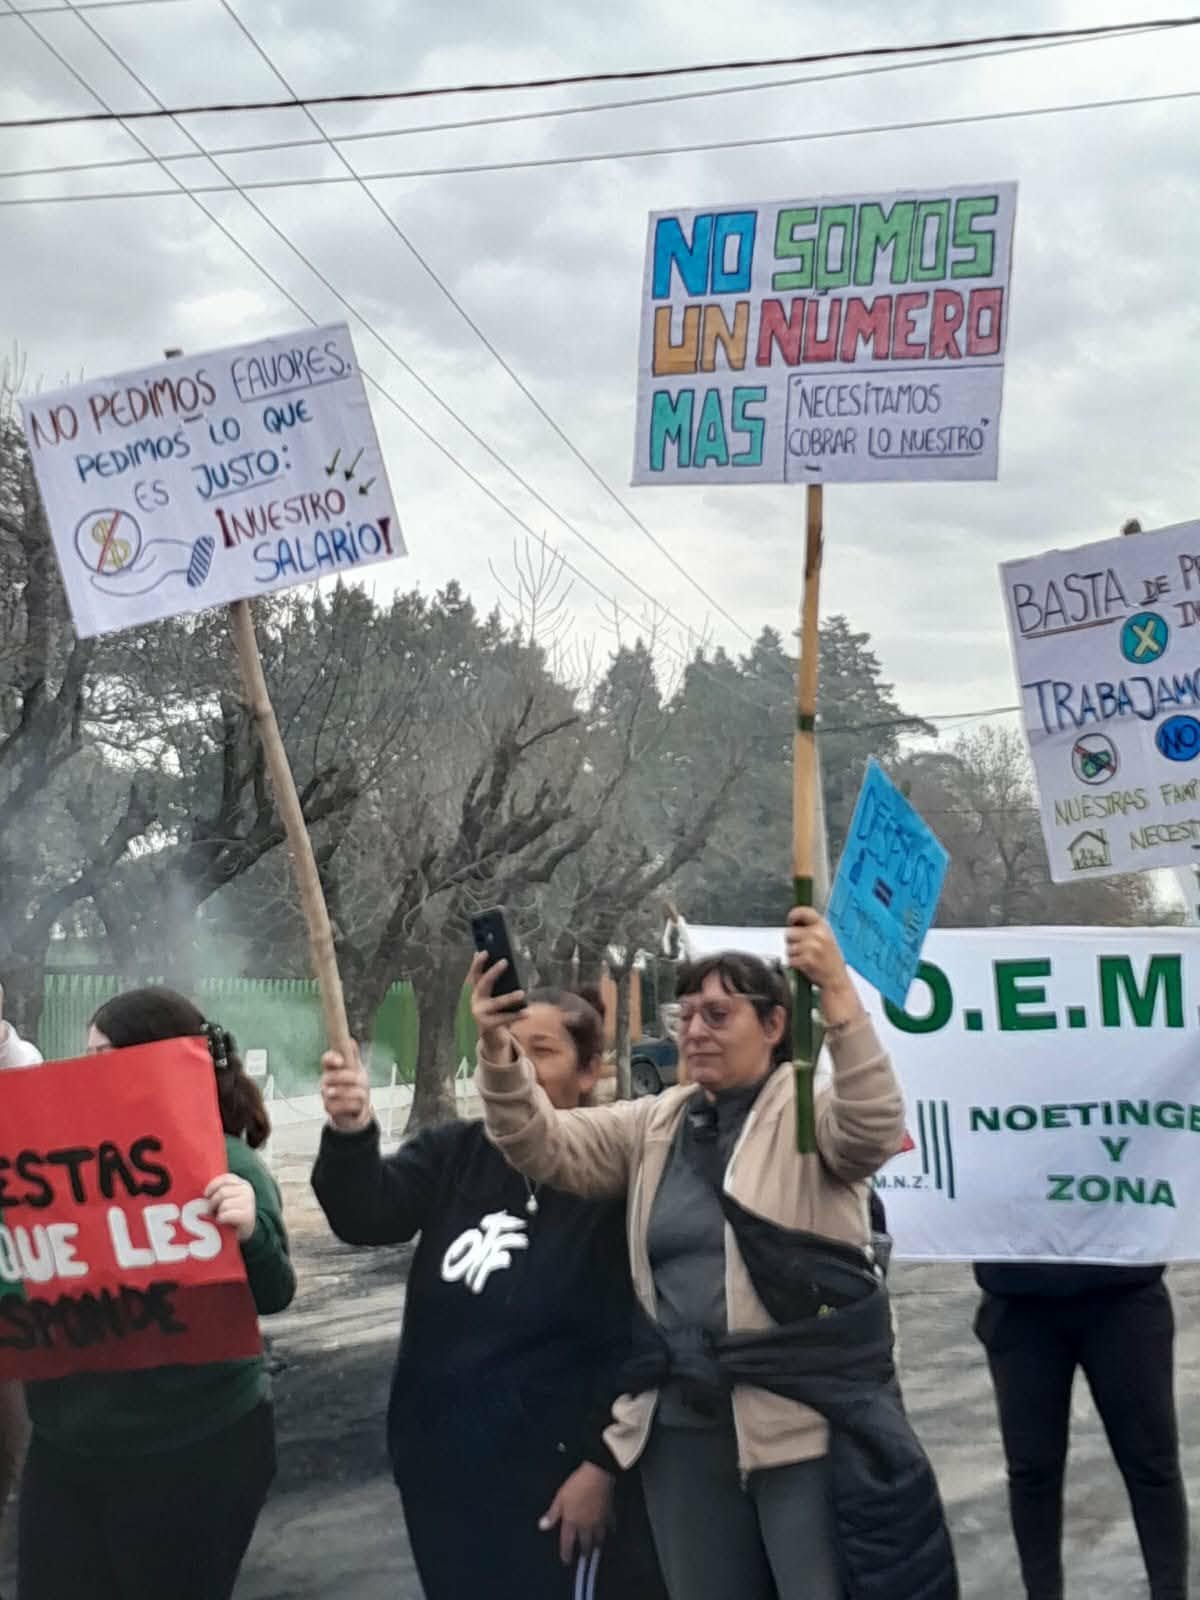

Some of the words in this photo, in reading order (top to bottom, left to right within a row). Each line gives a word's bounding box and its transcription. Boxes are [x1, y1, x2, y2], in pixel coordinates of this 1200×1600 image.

[651, 210, 758, 300] NO
[771, 195, 998, 292] SOMOS
[652, 301, 750, 377] UN
[29, 403, 78, 449] NO
[75, 431, 191, 483] PEDIMOS
[208, 416, 241, 446] LO
[262, 399, 314, 434] QUE
[649, 386, 767, 472] MAS
[788, 427, 857, 457] COBRAR
[868, 427, 892, 457] LO
[134, 479, 169, 513] ES
[1012, 567, 1129, 634] BASTA
[1055, 788, 1147, 826] NUESTRAS
[881, 953, 1200, 1034] O.E.M
[1100, 1136, 1130, 1163] Y
[1047, 1174, 1176, 1209] ZONA
[107, 1198, 222, 1269] LES
